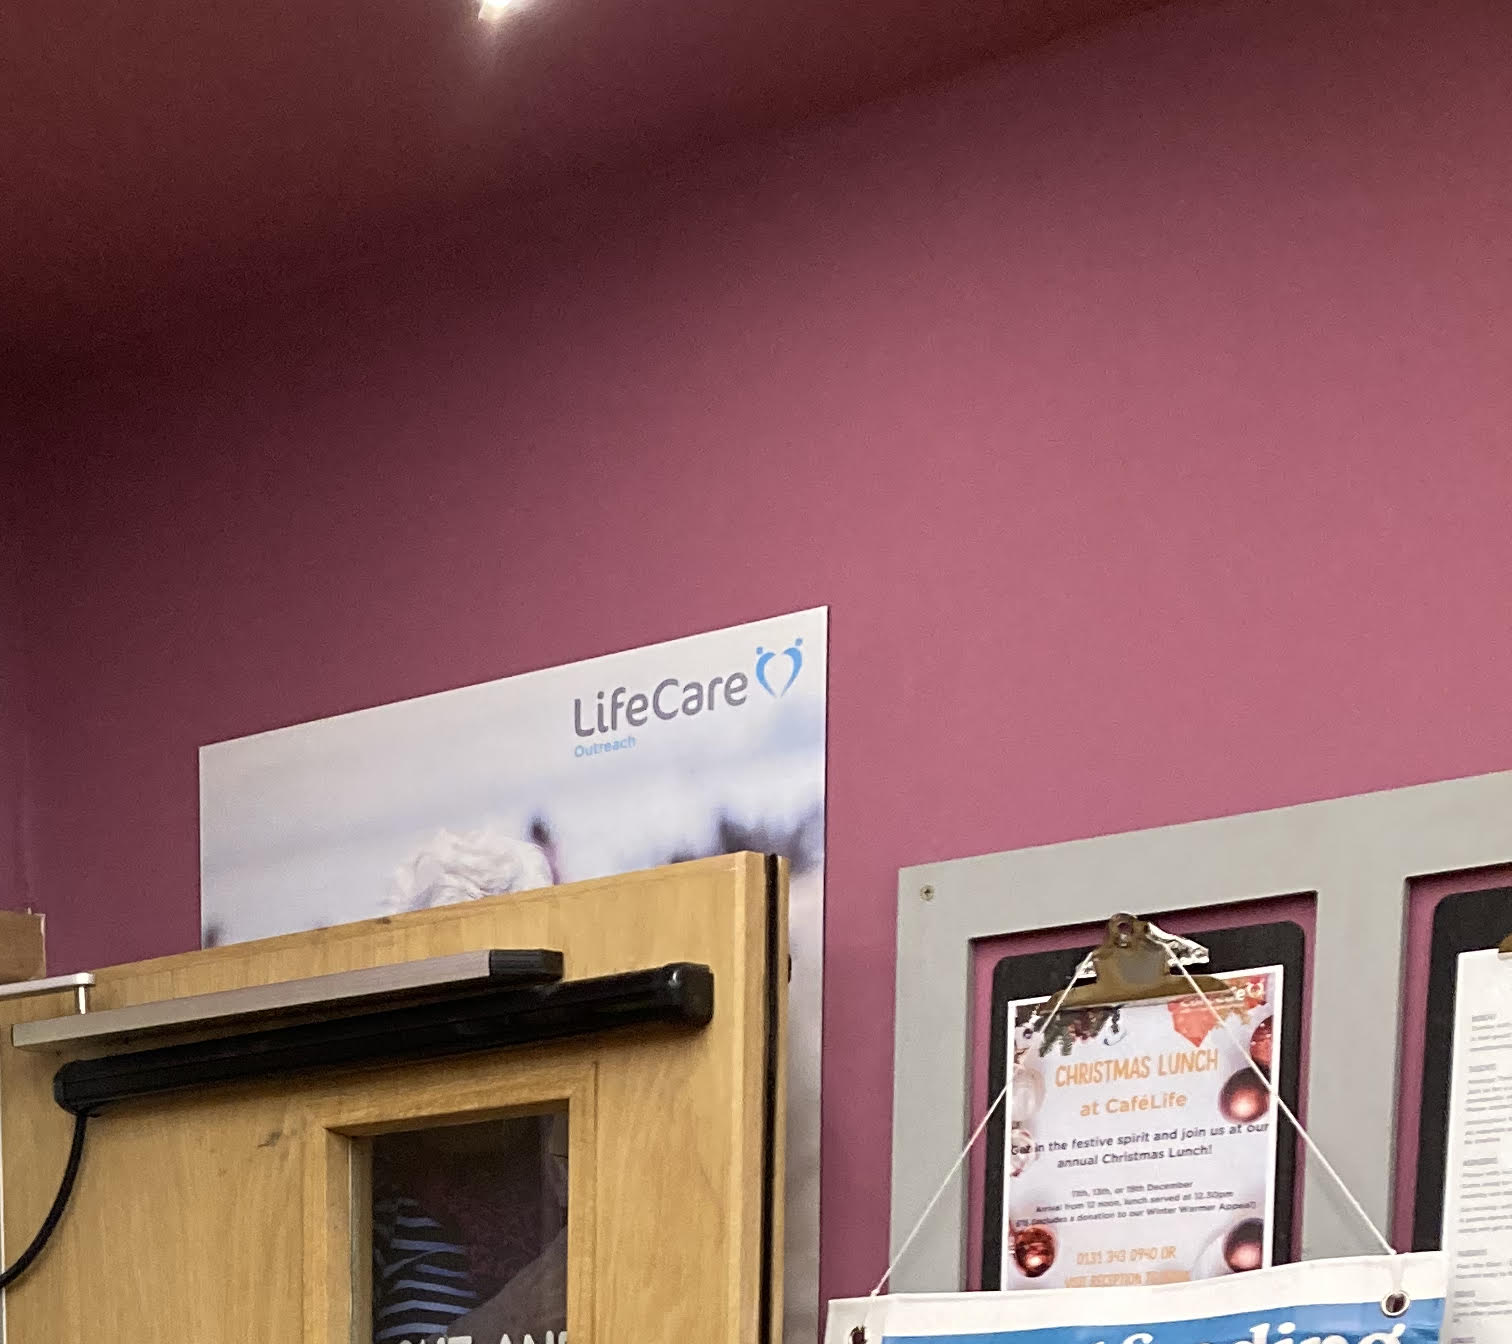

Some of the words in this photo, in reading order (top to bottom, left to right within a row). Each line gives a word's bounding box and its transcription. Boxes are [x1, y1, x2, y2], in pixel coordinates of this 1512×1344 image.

[574, 671, 748, 738] LifeCare
[574, 735, 637, 757] Outreach
[1055, 1055, 1152, 1088] CHRISTMAS
[1158, 1047, 1219, 1077] LUNCH
[1079, 1101, 1100, 1117] at
[1035, 1142, 1045, 1153] in
[1048, 1140, 1068, 1152] the
[1072, 1136, 1114, 1150] festive
[1117, 1132, 1150, 1146] spirit
[1153, 1129, 1178, 1141] and
[1181, 1125, 1206, 1141] join
[1210, 1127, 1225, 1136] us
[1229, 1125, 1242, 1135] at
[1246, 1123, 1269, 1132] our
[1057, 1155, 1099, 1168] annual
[1102, 1149, 1165, 1165] Christmas
[1169, 1144, 1213, 1158] Lunch!
[1147, 1182, 1193, 1191] December
[1151, 1194, 1180, 1203] served
[1077, 1212, 1115, 1221] donation
[1147, 1207, 1177, 1215] Winter
